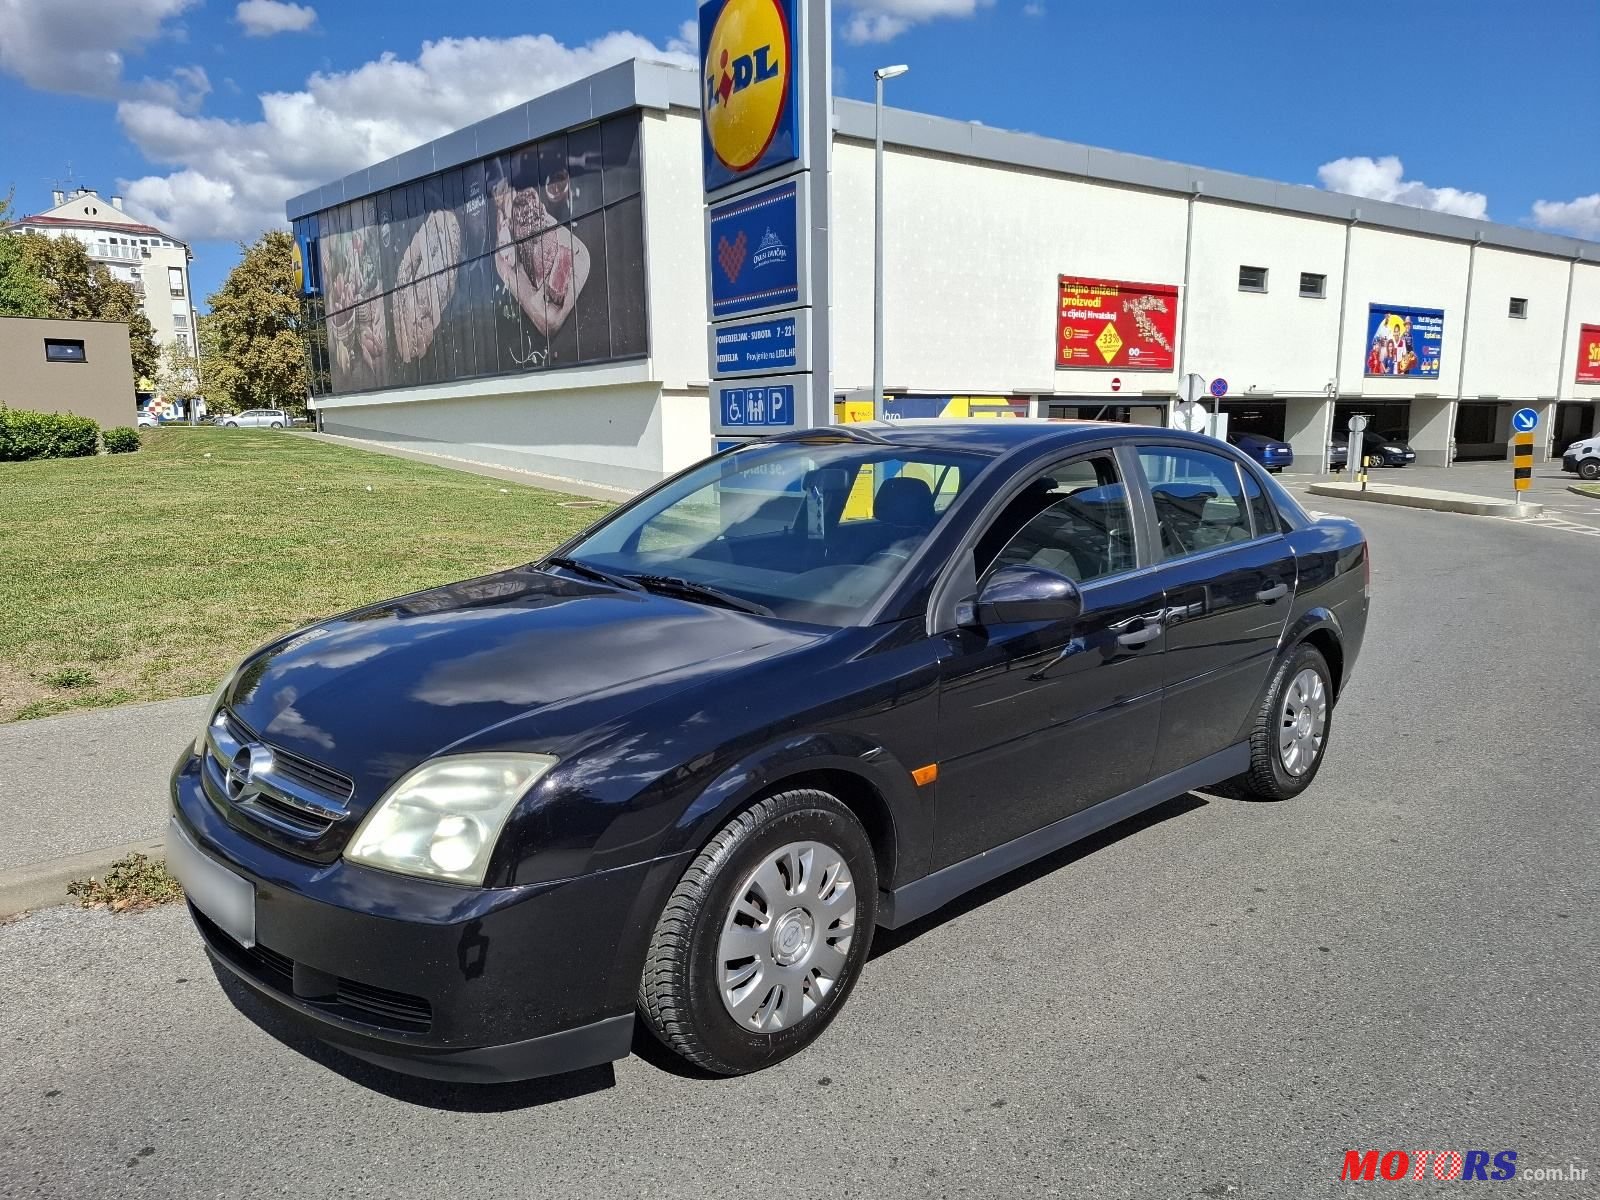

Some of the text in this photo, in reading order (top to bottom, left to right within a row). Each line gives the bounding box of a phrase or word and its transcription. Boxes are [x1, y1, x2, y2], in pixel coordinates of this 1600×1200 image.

[1063, 281, 1118, 297] Trajno sniženi
[1063, 295, 1102, 308] proizvodi
[1062, 309, 1117, 322] u cijeloj Hrvatskoj
[751, 329, 771, 340] SUBOTA
[776, 327, 781, 338] 7
[784, 325, 792, 337] 22
[772, 392, 783, 420] P
